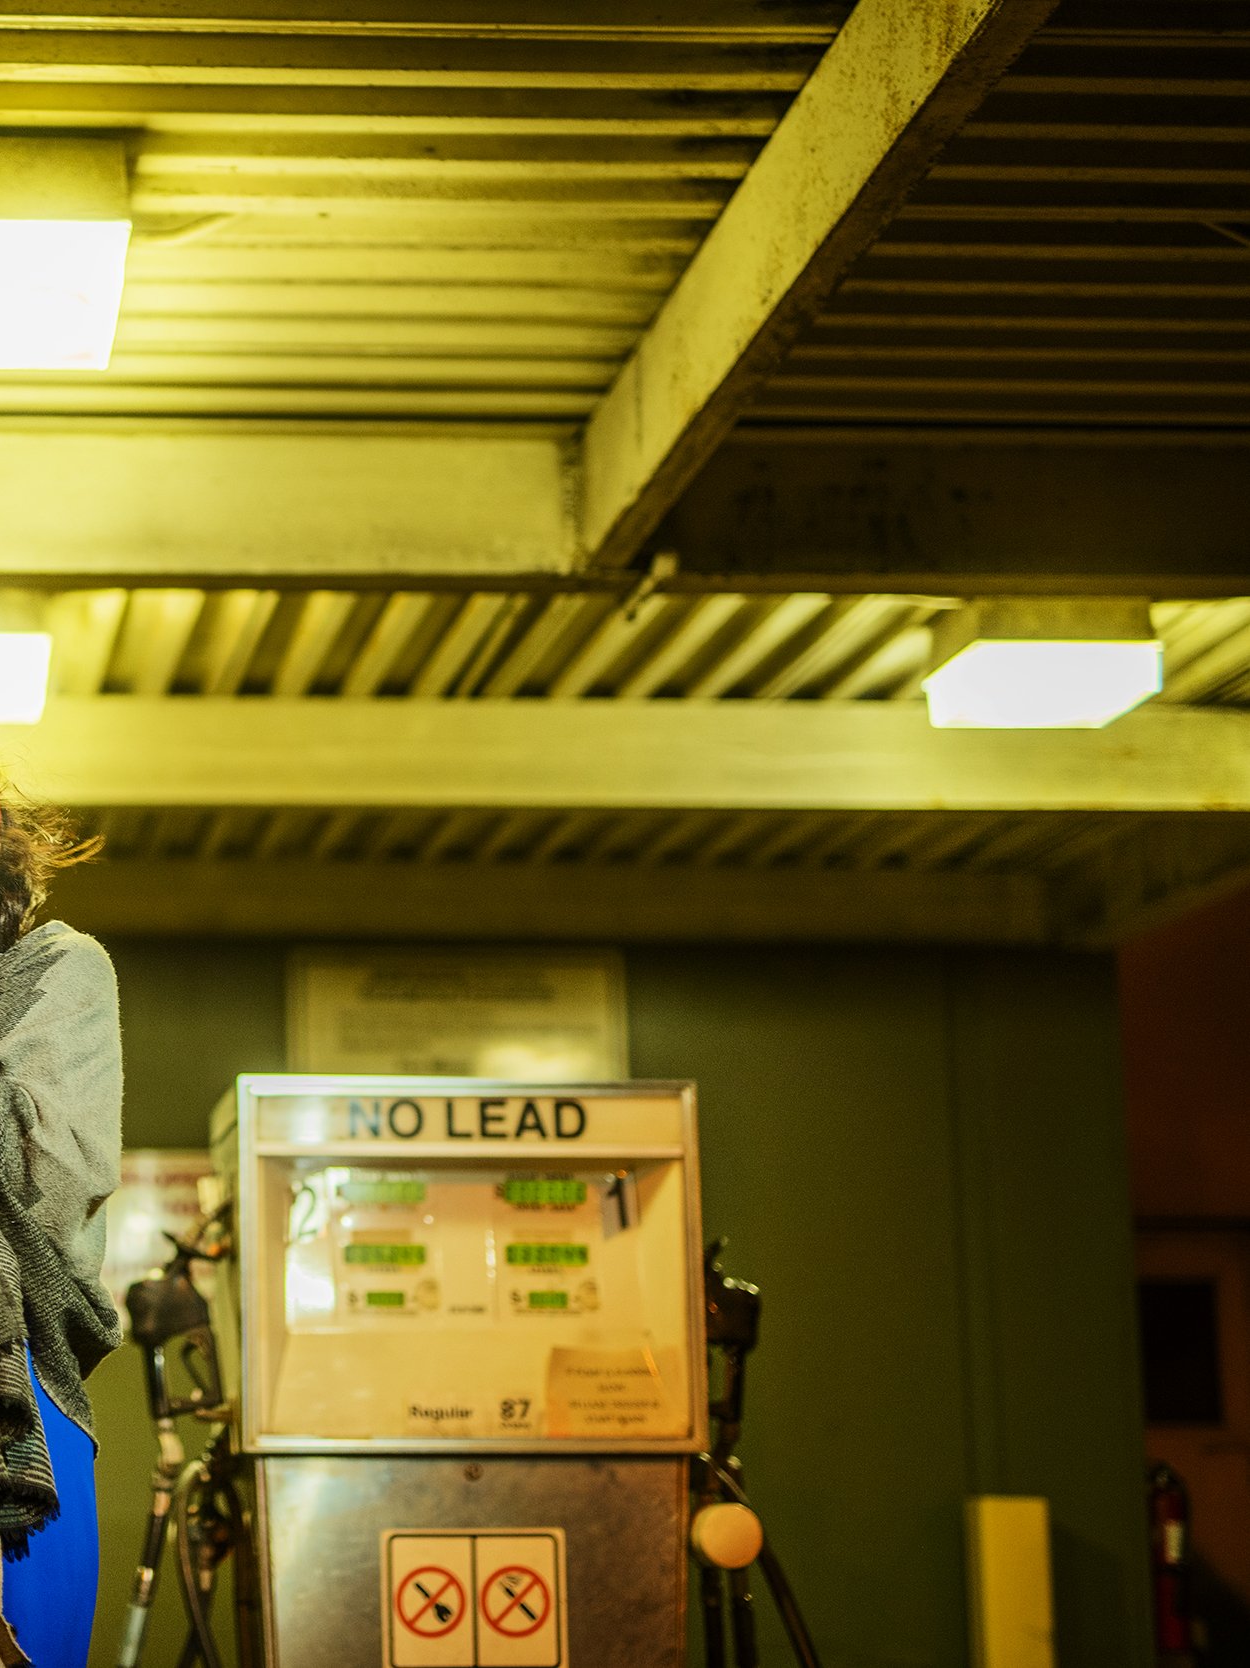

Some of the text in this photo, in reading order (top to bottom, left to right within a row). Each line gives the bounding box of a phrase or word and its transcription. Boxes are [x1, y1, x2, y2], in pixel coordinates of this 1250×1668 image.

[348, 1098, 587, 1139] NO LEAD
[298, 1186, 317, 1239] 2
[607, 1176, 629, 1230] 1
[408, 1405, 472, 1421] Regular
[500, 1399, 530, 1419] 87
